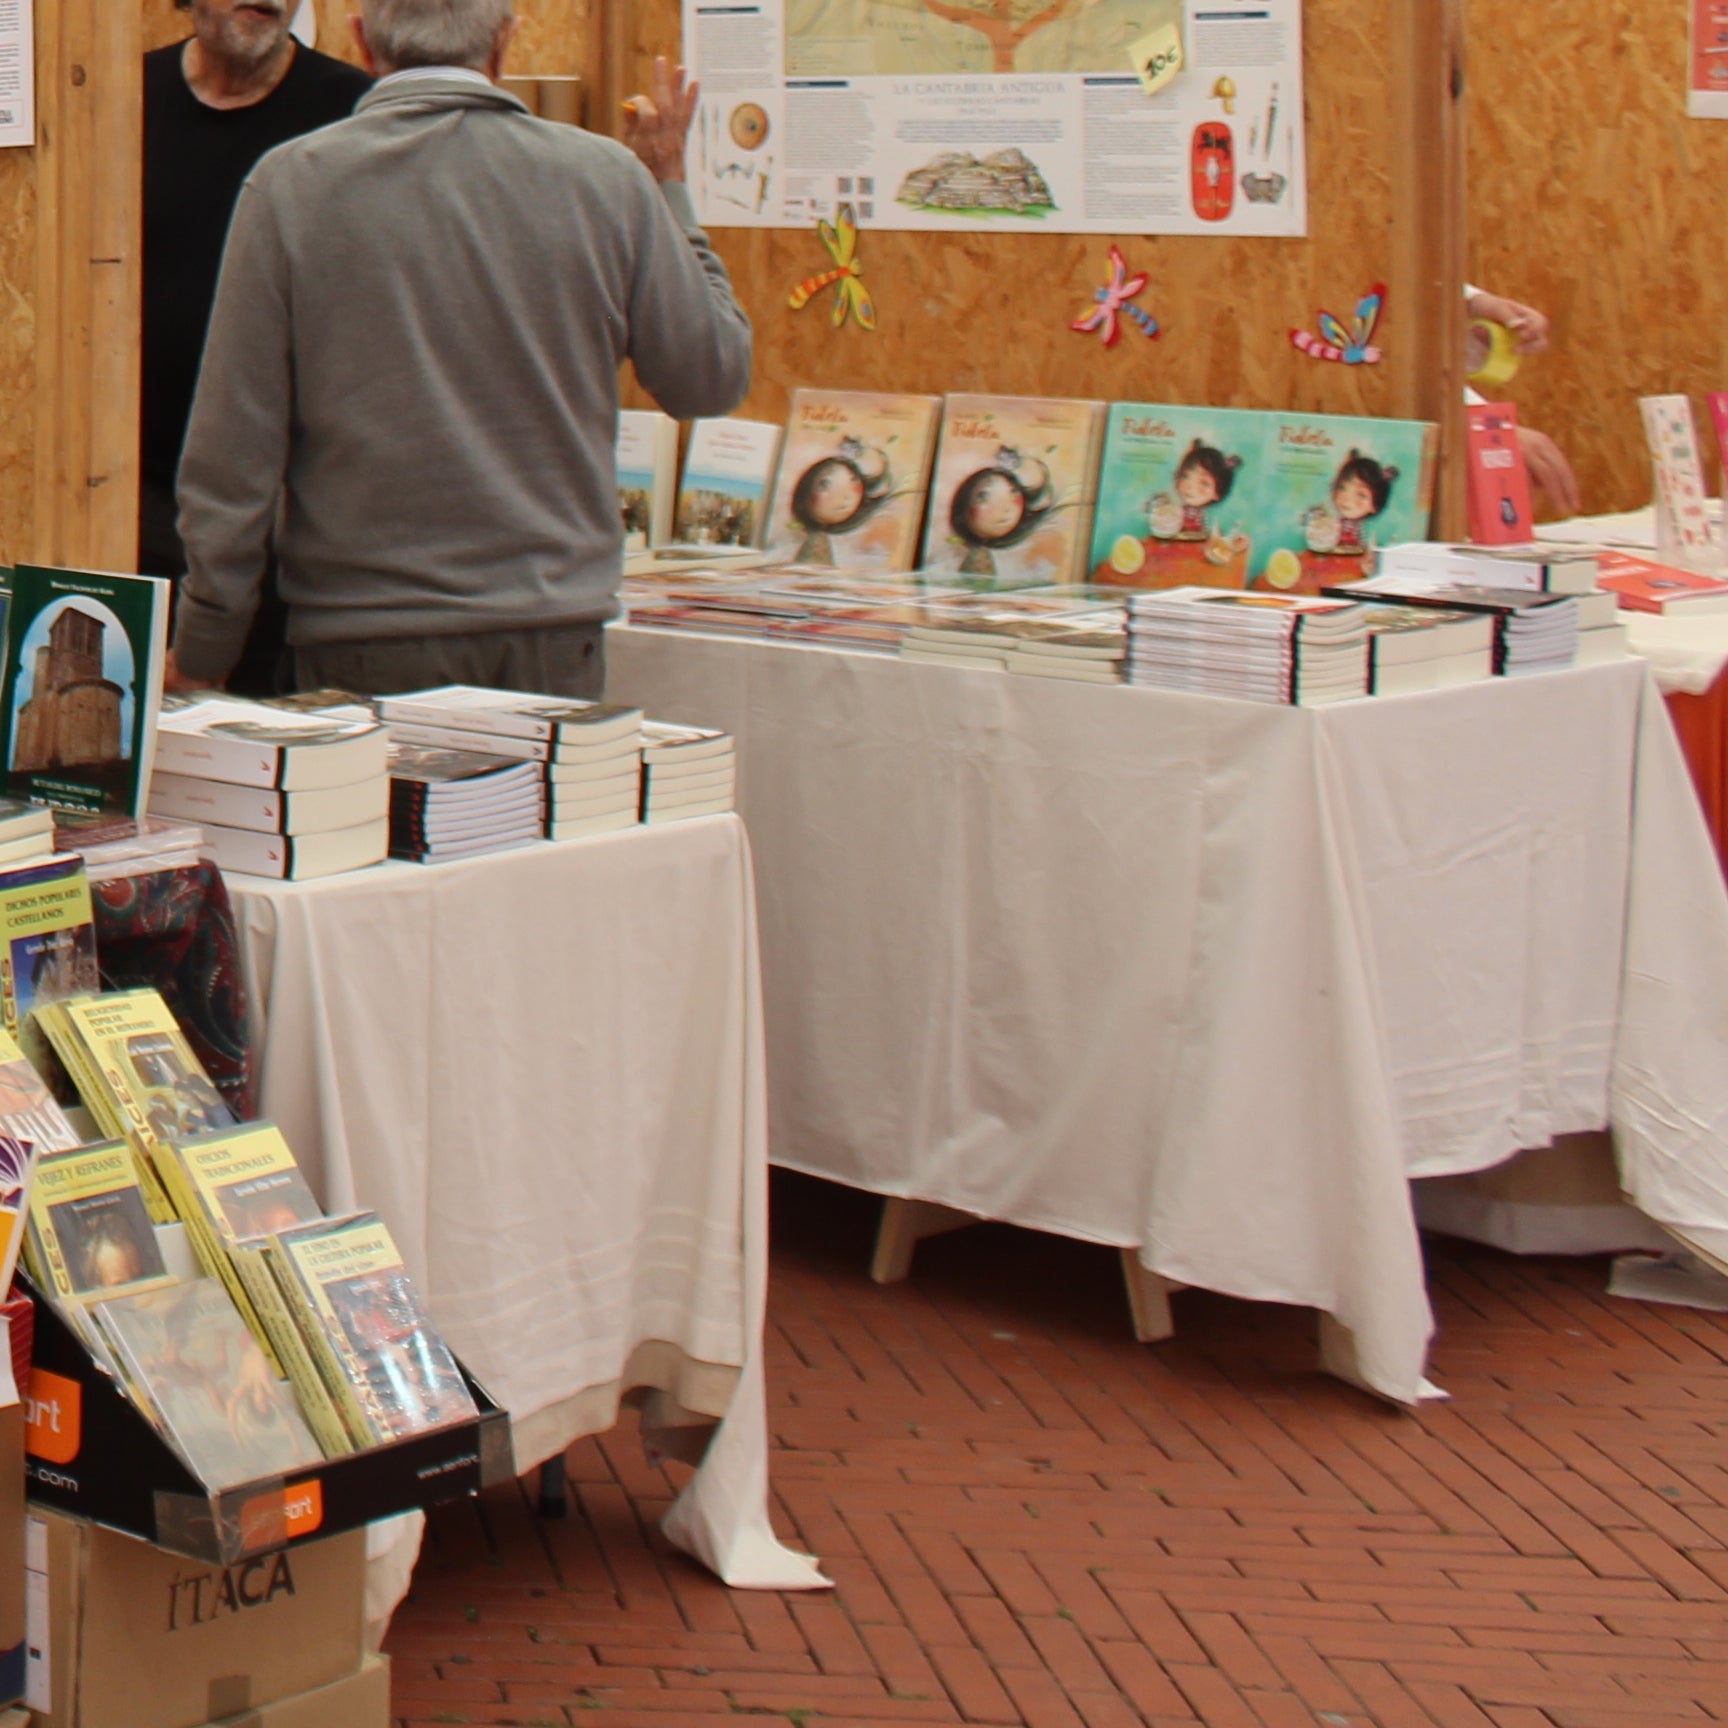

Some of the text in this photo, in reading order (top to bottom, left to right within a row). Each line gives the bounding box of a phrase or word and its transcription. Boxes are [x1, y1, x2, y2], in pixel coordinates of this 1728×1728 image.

[4, 888, 82, 912] DICHOS POPULARES
[7, 909, 65, 928] CASTELLANOS
